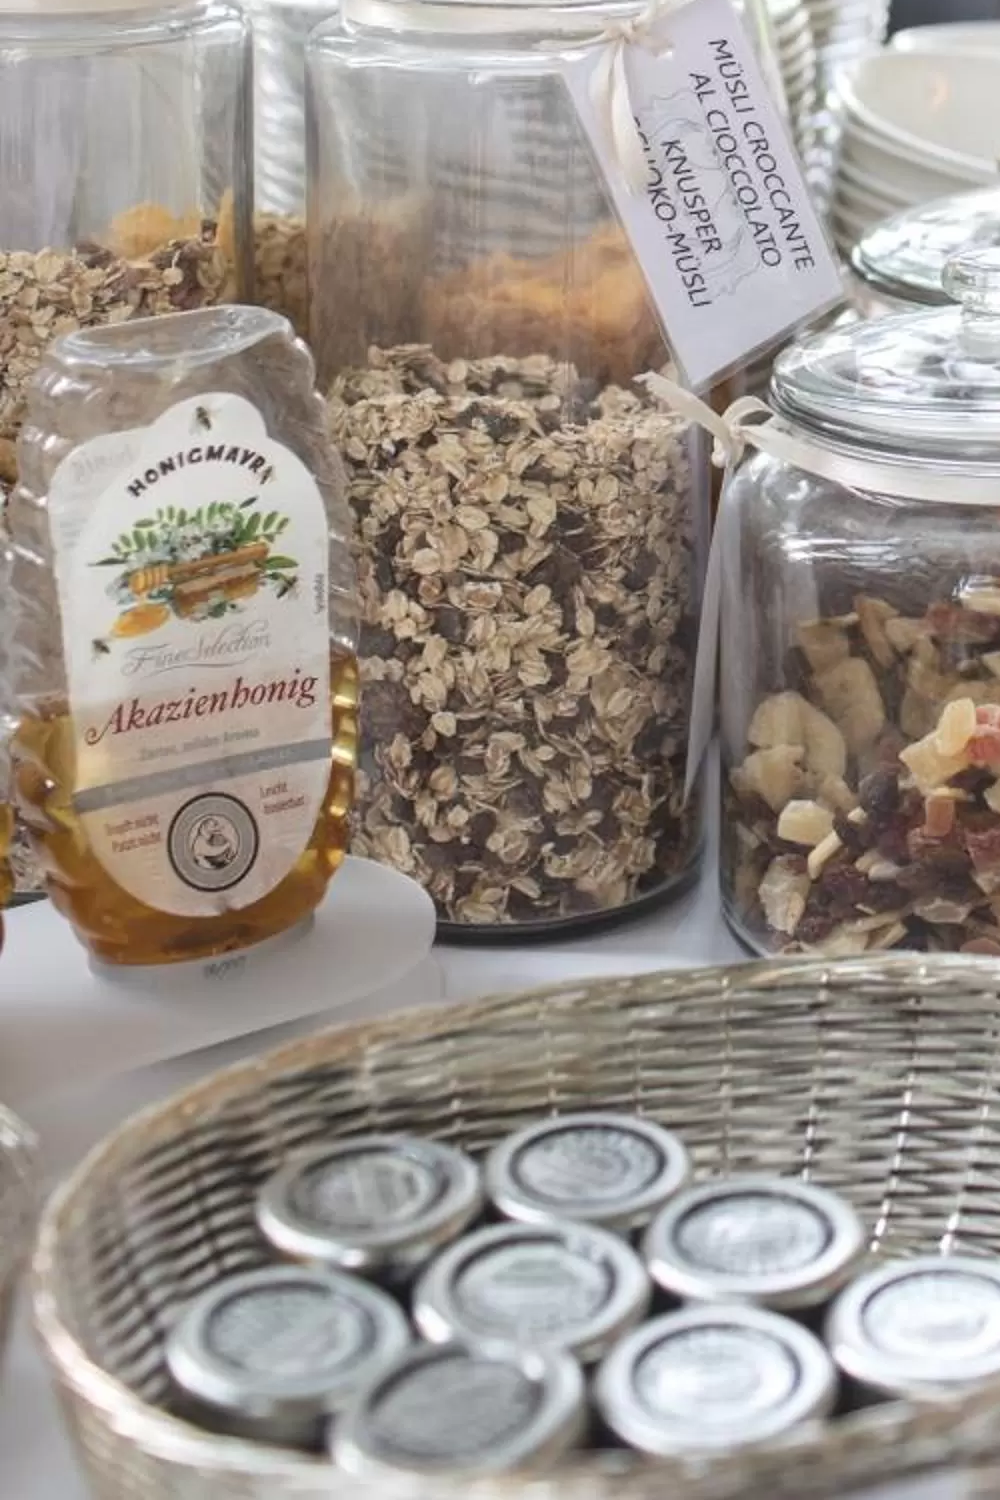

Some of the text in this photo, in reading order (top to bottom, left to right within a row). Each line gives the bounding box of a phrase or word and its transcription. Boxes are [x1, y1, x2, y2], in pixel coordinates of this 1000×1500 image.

[661, 139, 722, 254] KNUSPER
[689, 72, 782, 267] AL CIOCCOLATO
[709, 39, 815, 271] MÜSLI CROCCANTE
[84, 667, 319, 746] Akazienhonig
